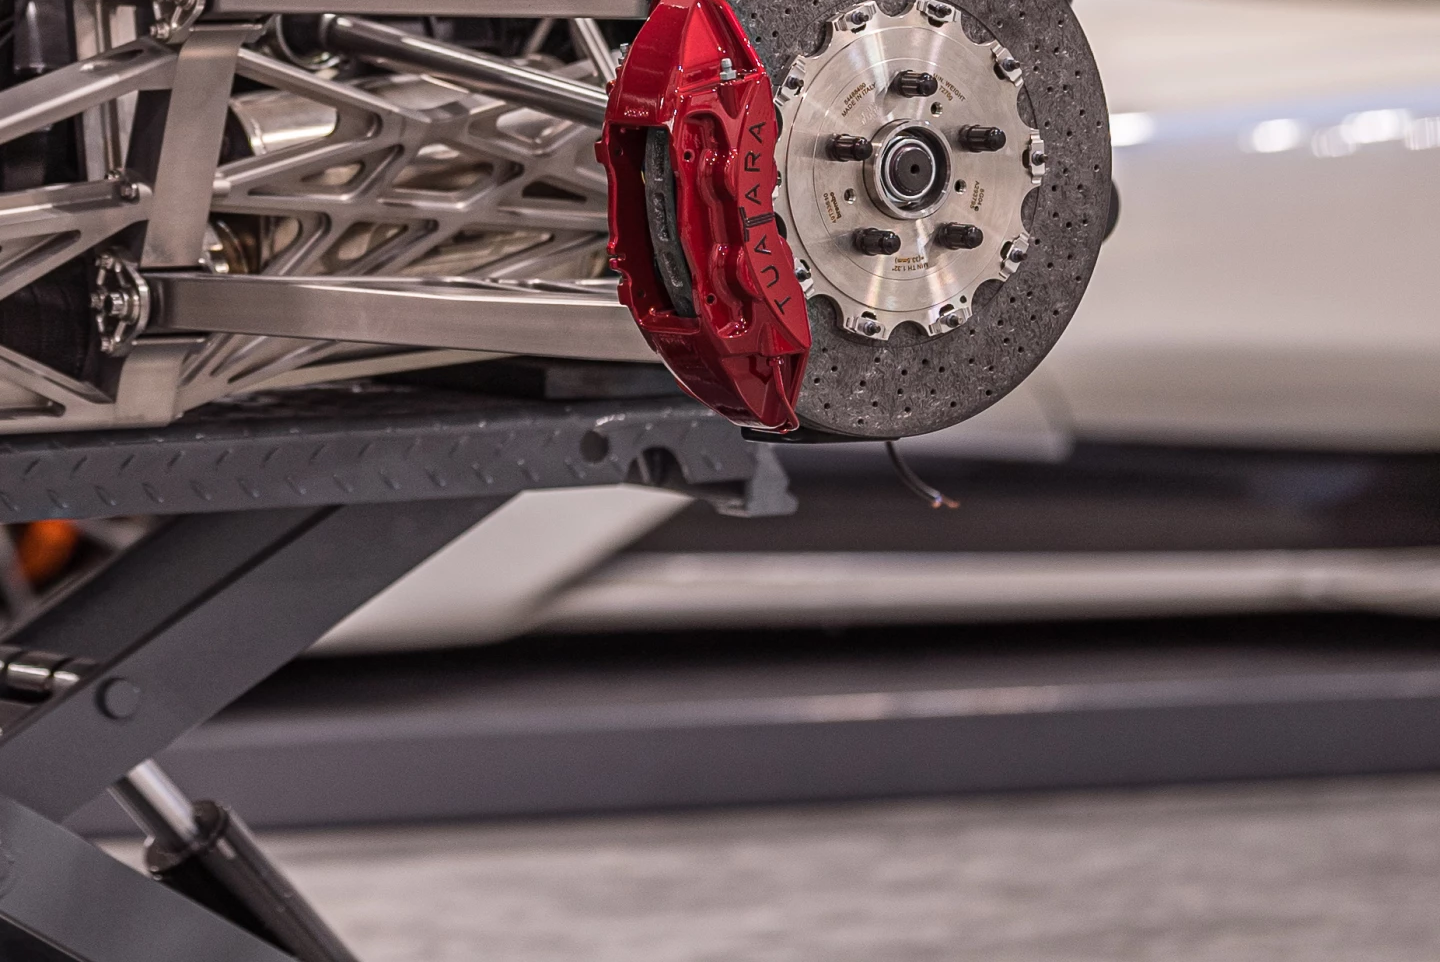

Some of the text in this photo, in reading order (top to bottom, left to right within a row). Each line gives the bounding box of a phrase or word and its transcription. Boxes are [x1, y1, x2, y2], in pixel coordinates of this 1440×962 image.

[841, 100, 856, 117] MADE
[855, 94, 863, 102] IN
[861, 82, 876, 96] ITALY
[945, 80, 966, 102] WEIGHT
[737, 121, 792, 316] TUATARA
[830, 191, 842, 219] brembo
